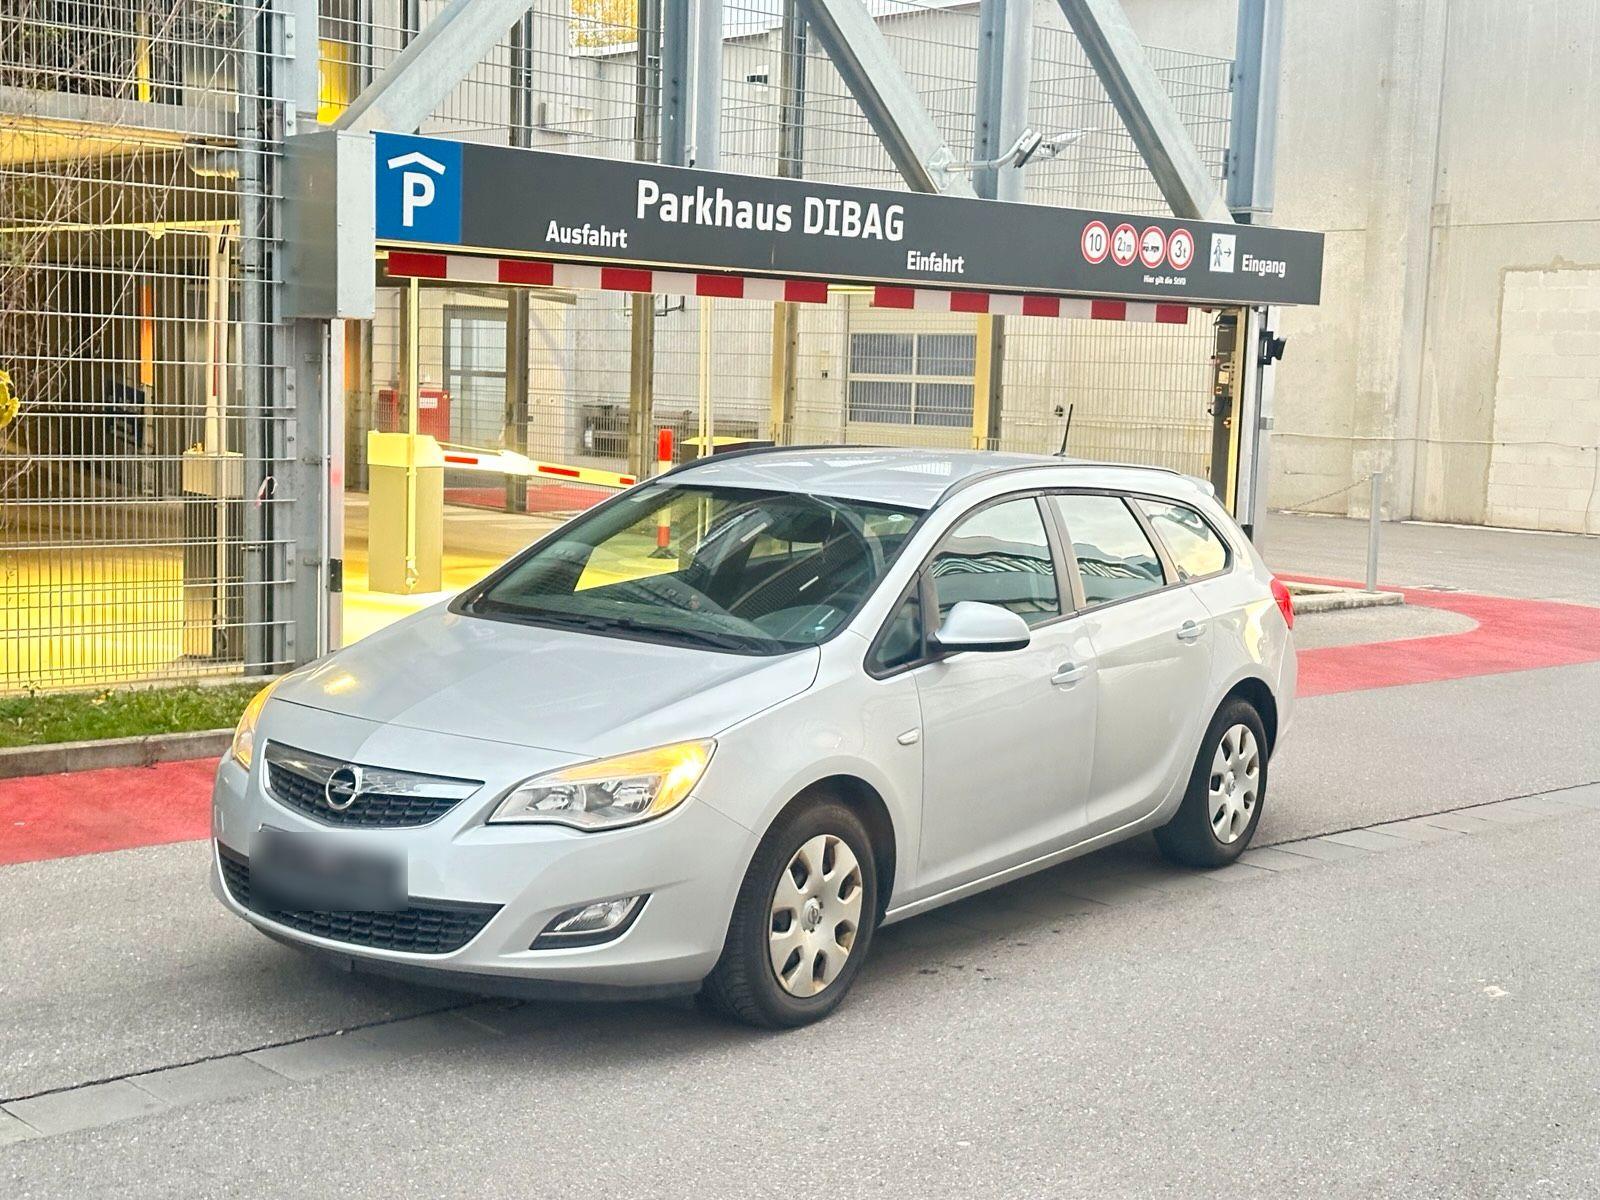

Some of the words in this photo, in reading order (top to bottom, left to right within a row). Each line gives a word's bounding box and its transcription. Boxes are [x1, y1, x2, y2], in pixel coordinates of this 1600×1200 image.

[403, 171, 435, 227] P
[637, 179, 792, 233] Parkhaus
[803, 196, 904, 242] DIBAG
[545, 220, 628, 249] Ausfahrt
[1089, 233, 1103, 252] 10
[906, 250, 964, 275] Einfahrt
[1241, 254, 1286, 278] Eingang
